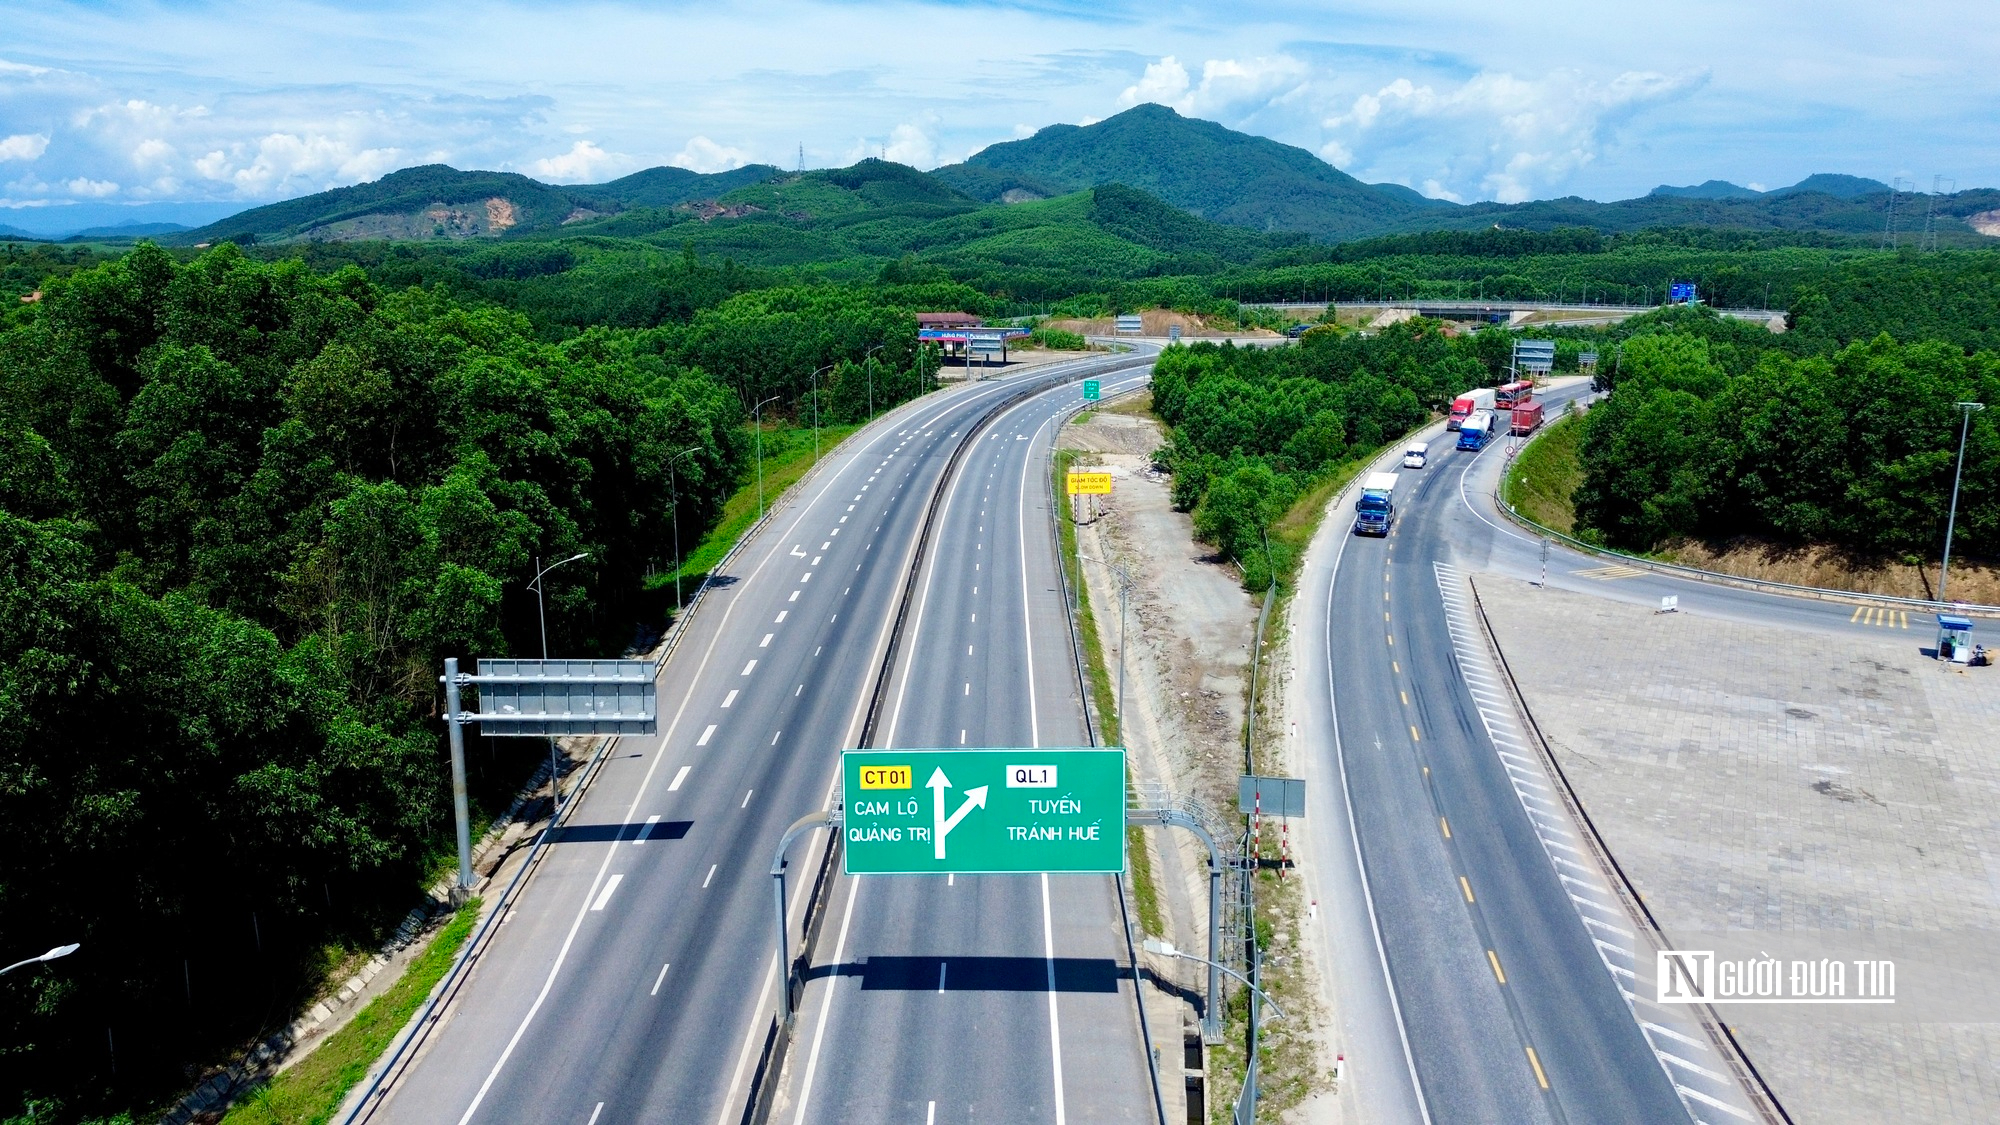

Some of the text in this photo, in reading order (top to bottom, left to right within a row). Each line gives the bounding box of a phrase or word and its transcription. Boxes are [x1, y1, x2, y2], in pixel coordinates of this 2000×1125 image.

[1015, 769, 1047, 784] QL.1
[854, 796, 919, 819] CAM LỘ
[1028, 792, 1081, 814] TUYẾN
[849, 822, 931, 845] QUẢNG TRỊ
[1006, 818, 1102, 841] TRÁNH HUẾ
